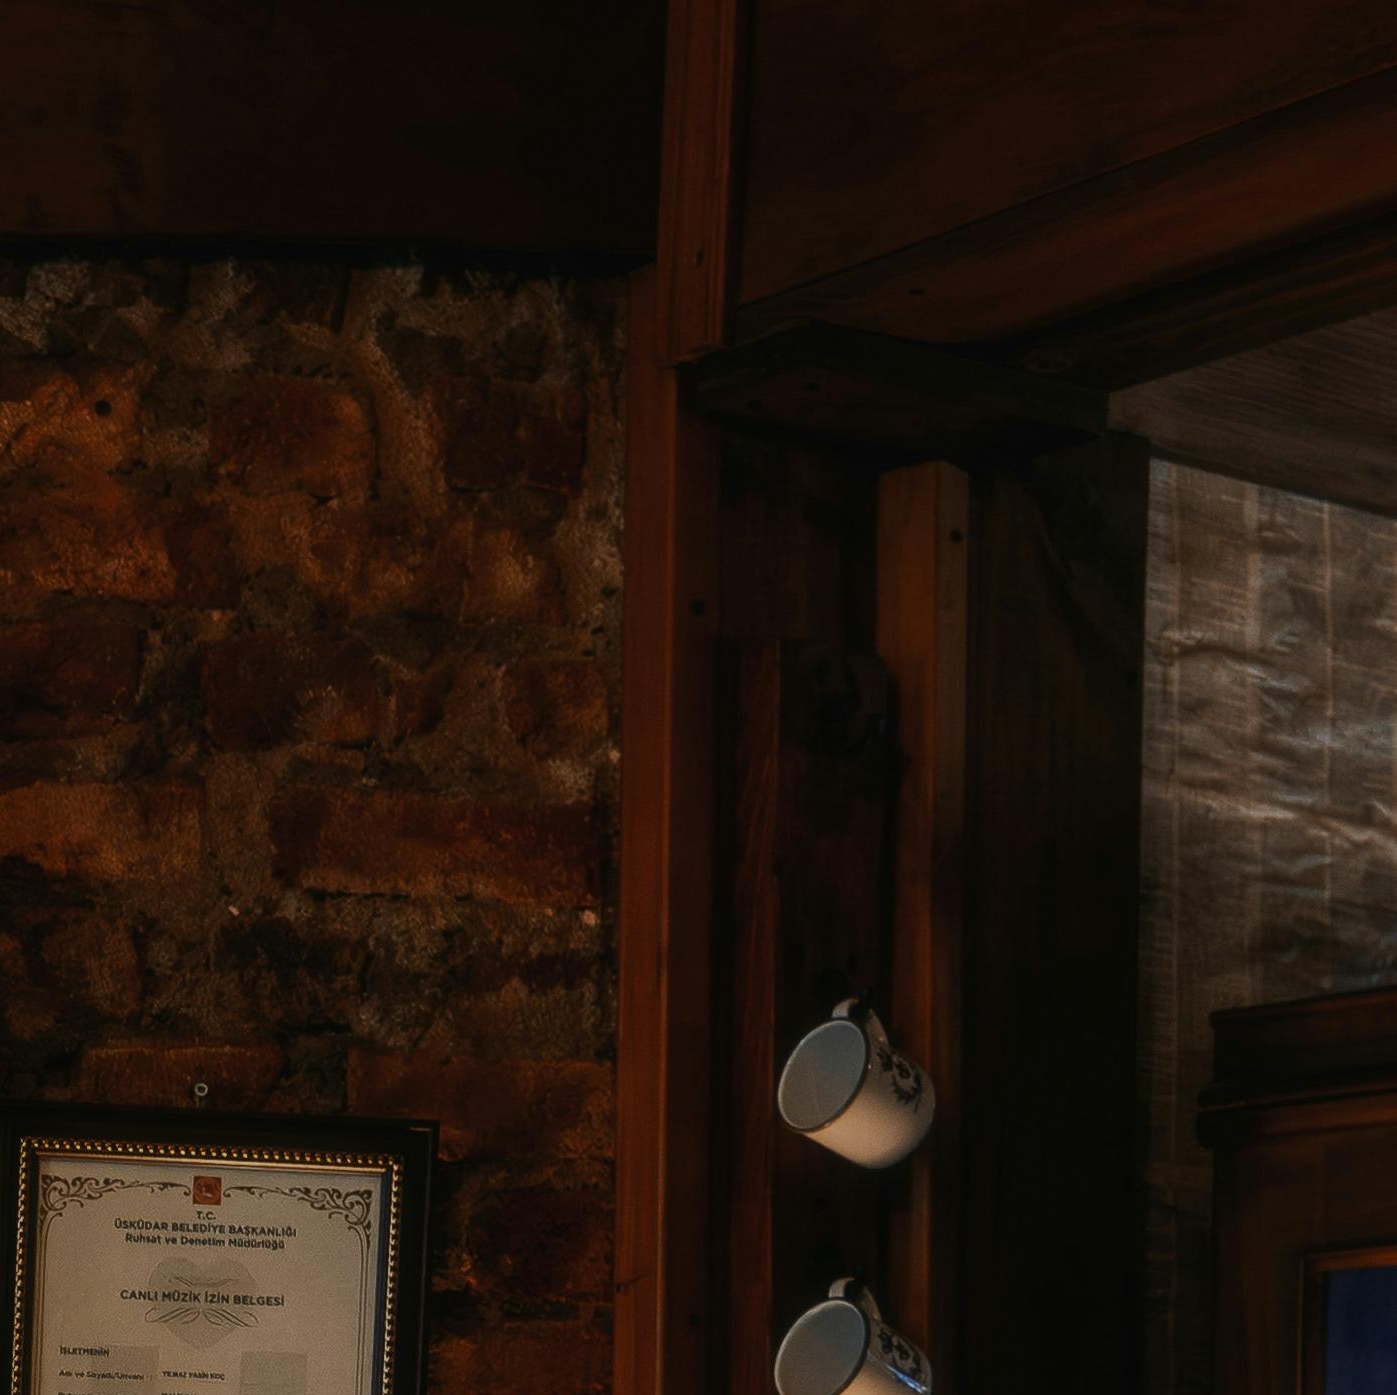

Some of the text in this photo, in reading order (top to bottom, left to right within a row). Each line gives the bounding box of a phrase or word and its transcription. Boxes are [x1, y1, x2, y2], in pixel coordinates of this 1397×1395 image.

[196, 1211, 217, 1221] T.C.
[114, 1218, 297, 1239] ÜSKÜDAR BELEDİYE BAŞKANLIĞI
[125, 1233, 161, 1244] Ruhsat
[182, 1237, 225, 1247] Denetim
[228, 1239, 284, 1251] Müdürlüğü
[120, 1289, 284, 1307] CANLI MÜZİK İZİN BELGESİ
